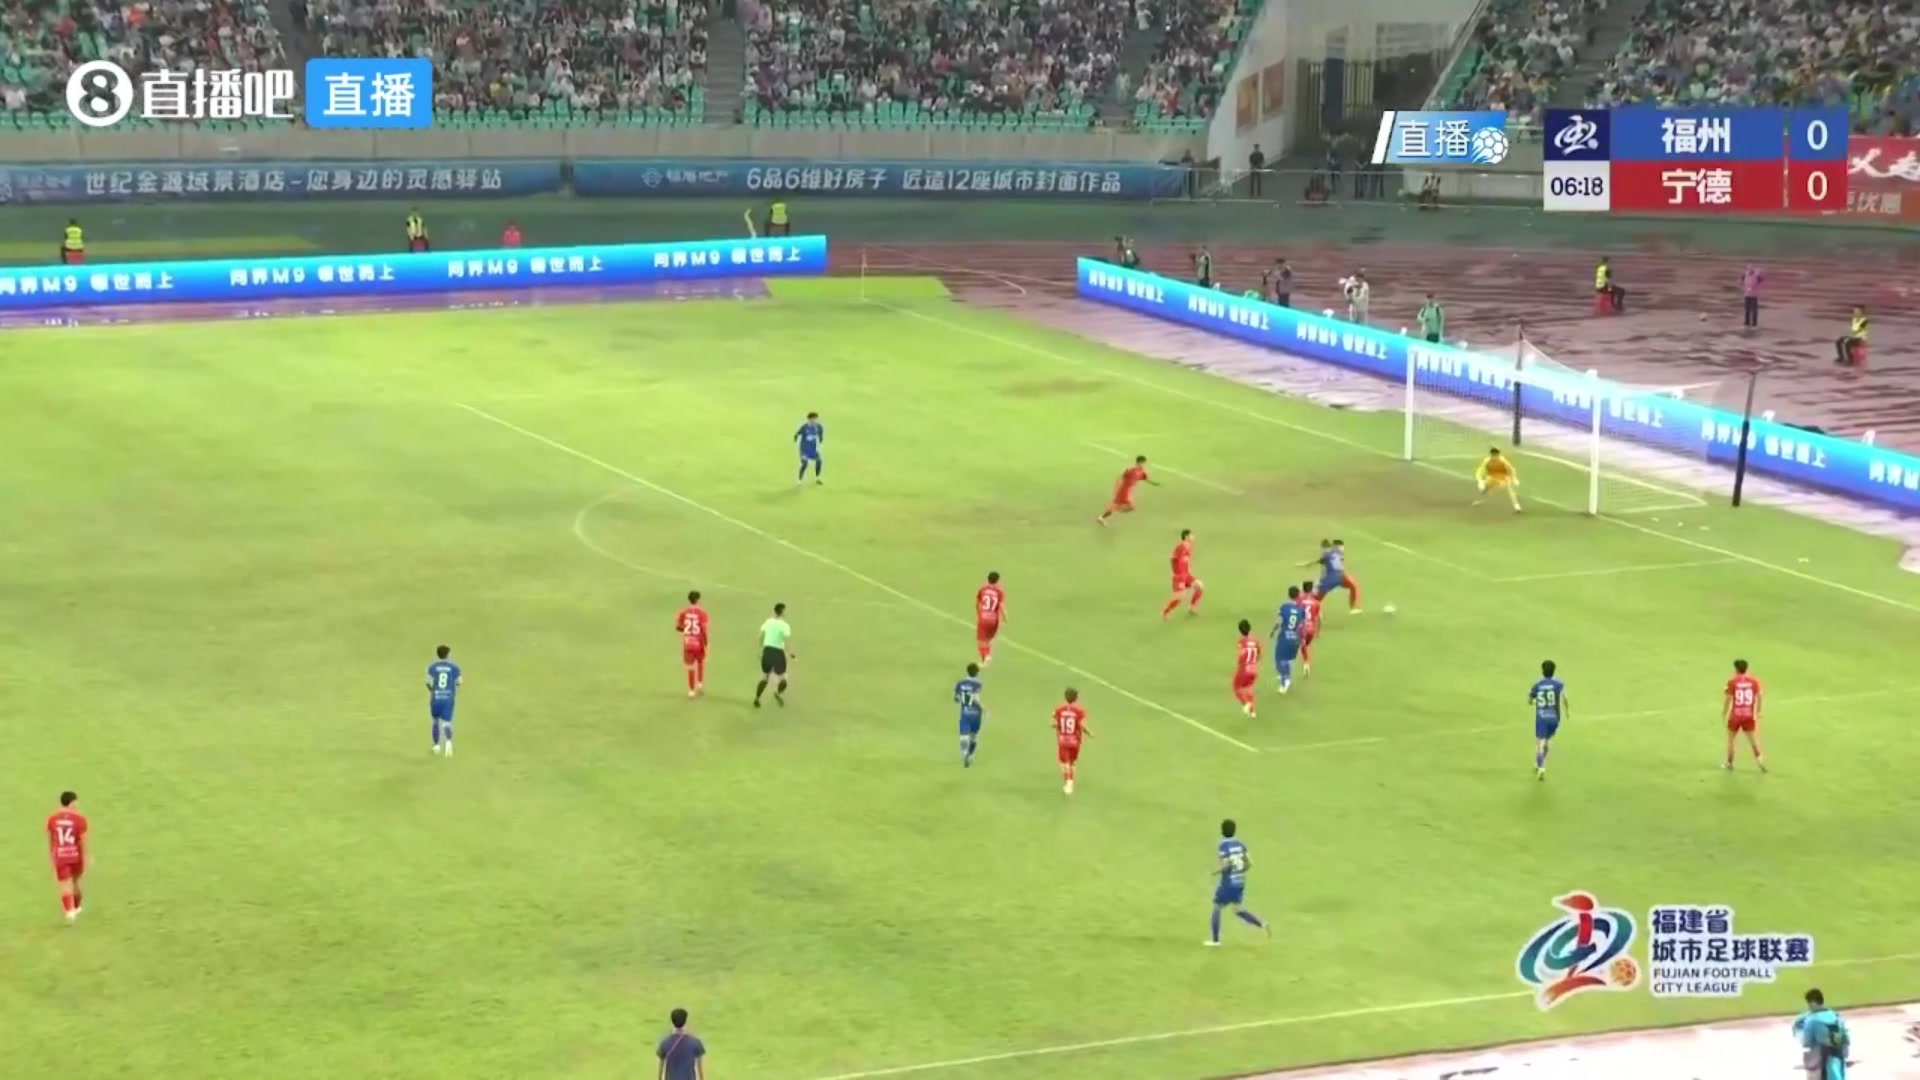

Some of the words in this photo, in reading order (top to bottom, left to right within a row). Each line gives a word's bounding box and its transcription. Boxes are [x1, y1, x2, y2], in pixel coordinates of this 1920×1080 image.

[982, 594, 998, 611] 37
[684, 618, 700, 634] 25
[1289, 614, 1297, 629] 9
[438, 672, 448, 688] 8
[1536, 691, 1555, 707] 59
[1735, 689, 1753, 706] 99
[1060, 718, 1076, 734] 19
[56, 827, 76, 846] 14
